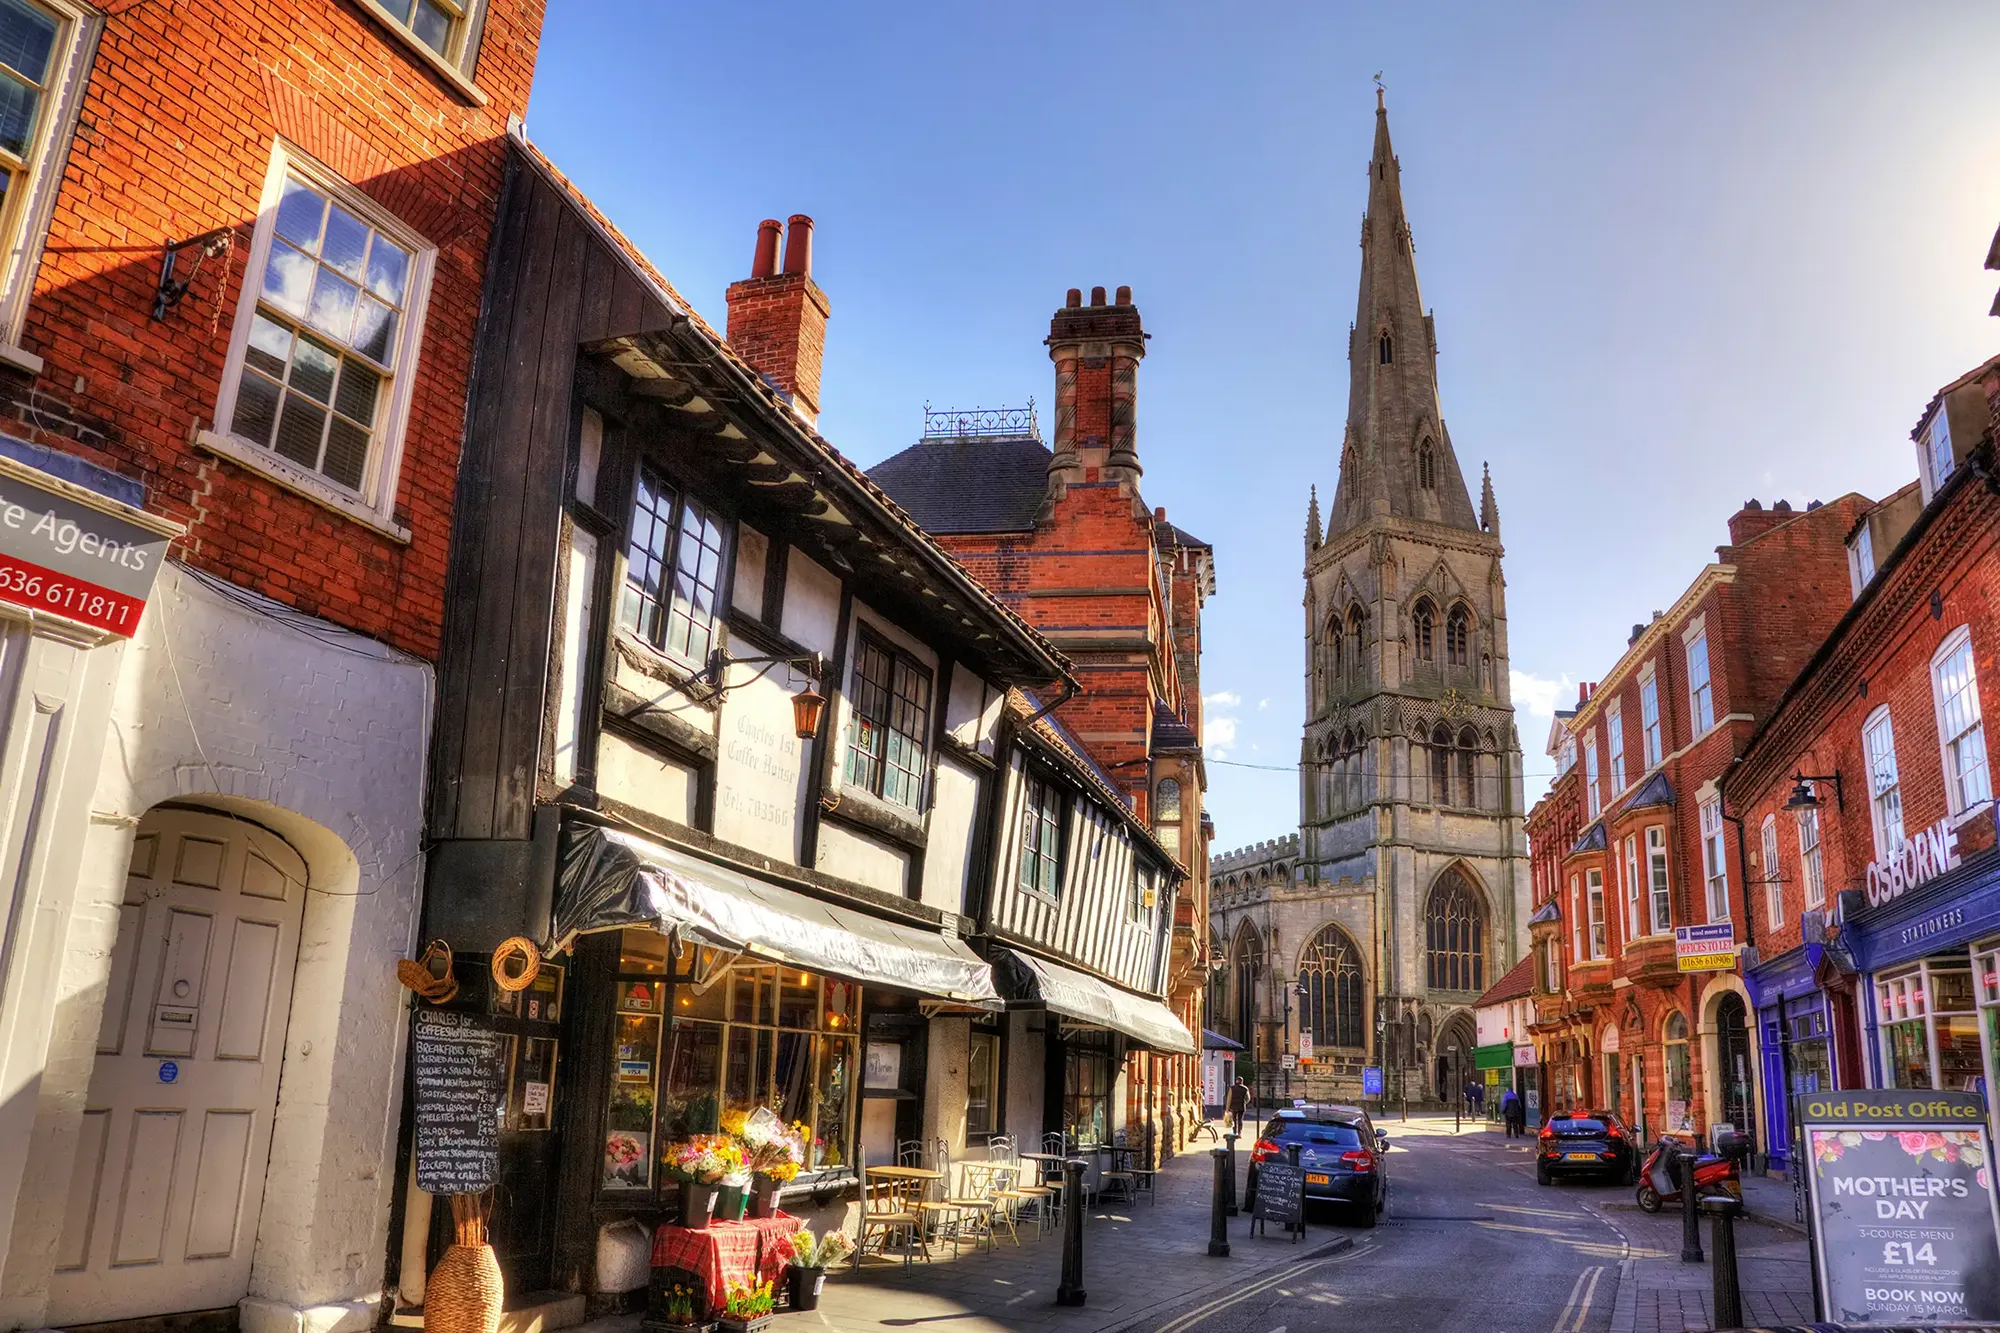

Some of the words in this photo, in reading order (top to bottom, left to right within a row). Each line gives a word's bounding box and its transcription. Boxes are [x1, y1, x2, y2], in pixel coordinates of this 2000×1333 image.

[31, 509, 148, 572] Agents
[45, 583, 130, 625] 611811
[1867, 818, 1962, 908] OSBORNE
[1901, 908, 1963, 943] STATIONERS
[1677, 941, 1707, 953] OFFICES
[1708, 941, 1718, 951] TO
[1719, 939, 1733, 950] LET
[448, 1067, 472, 1075] SALAD
[1808, 1102, 1848, 1117] Old
[1853, 1102, 1903, 1118] Post
[1908, 1102, 1977, 1118] Office
[1833, 1176, 1969, 1198] MOTHER’S
[1875, 1200, 1929, 1220] DAY
[1859, 1229, 1917, 1239] 3-COURSE
[1920, 1230, 1954, 1240] MENU
[1882, 1241, 1938, 1266] £14
[1865, 1288, 1916, 1302] BOOK
[1920, 1289, 1965, 1304] NOW
[1866, 1302, 1910, 1312] SUNDAY
[1914, 1304, 1924, 1314] 15
[1926, 1304, 1969, 1315] MARCH
